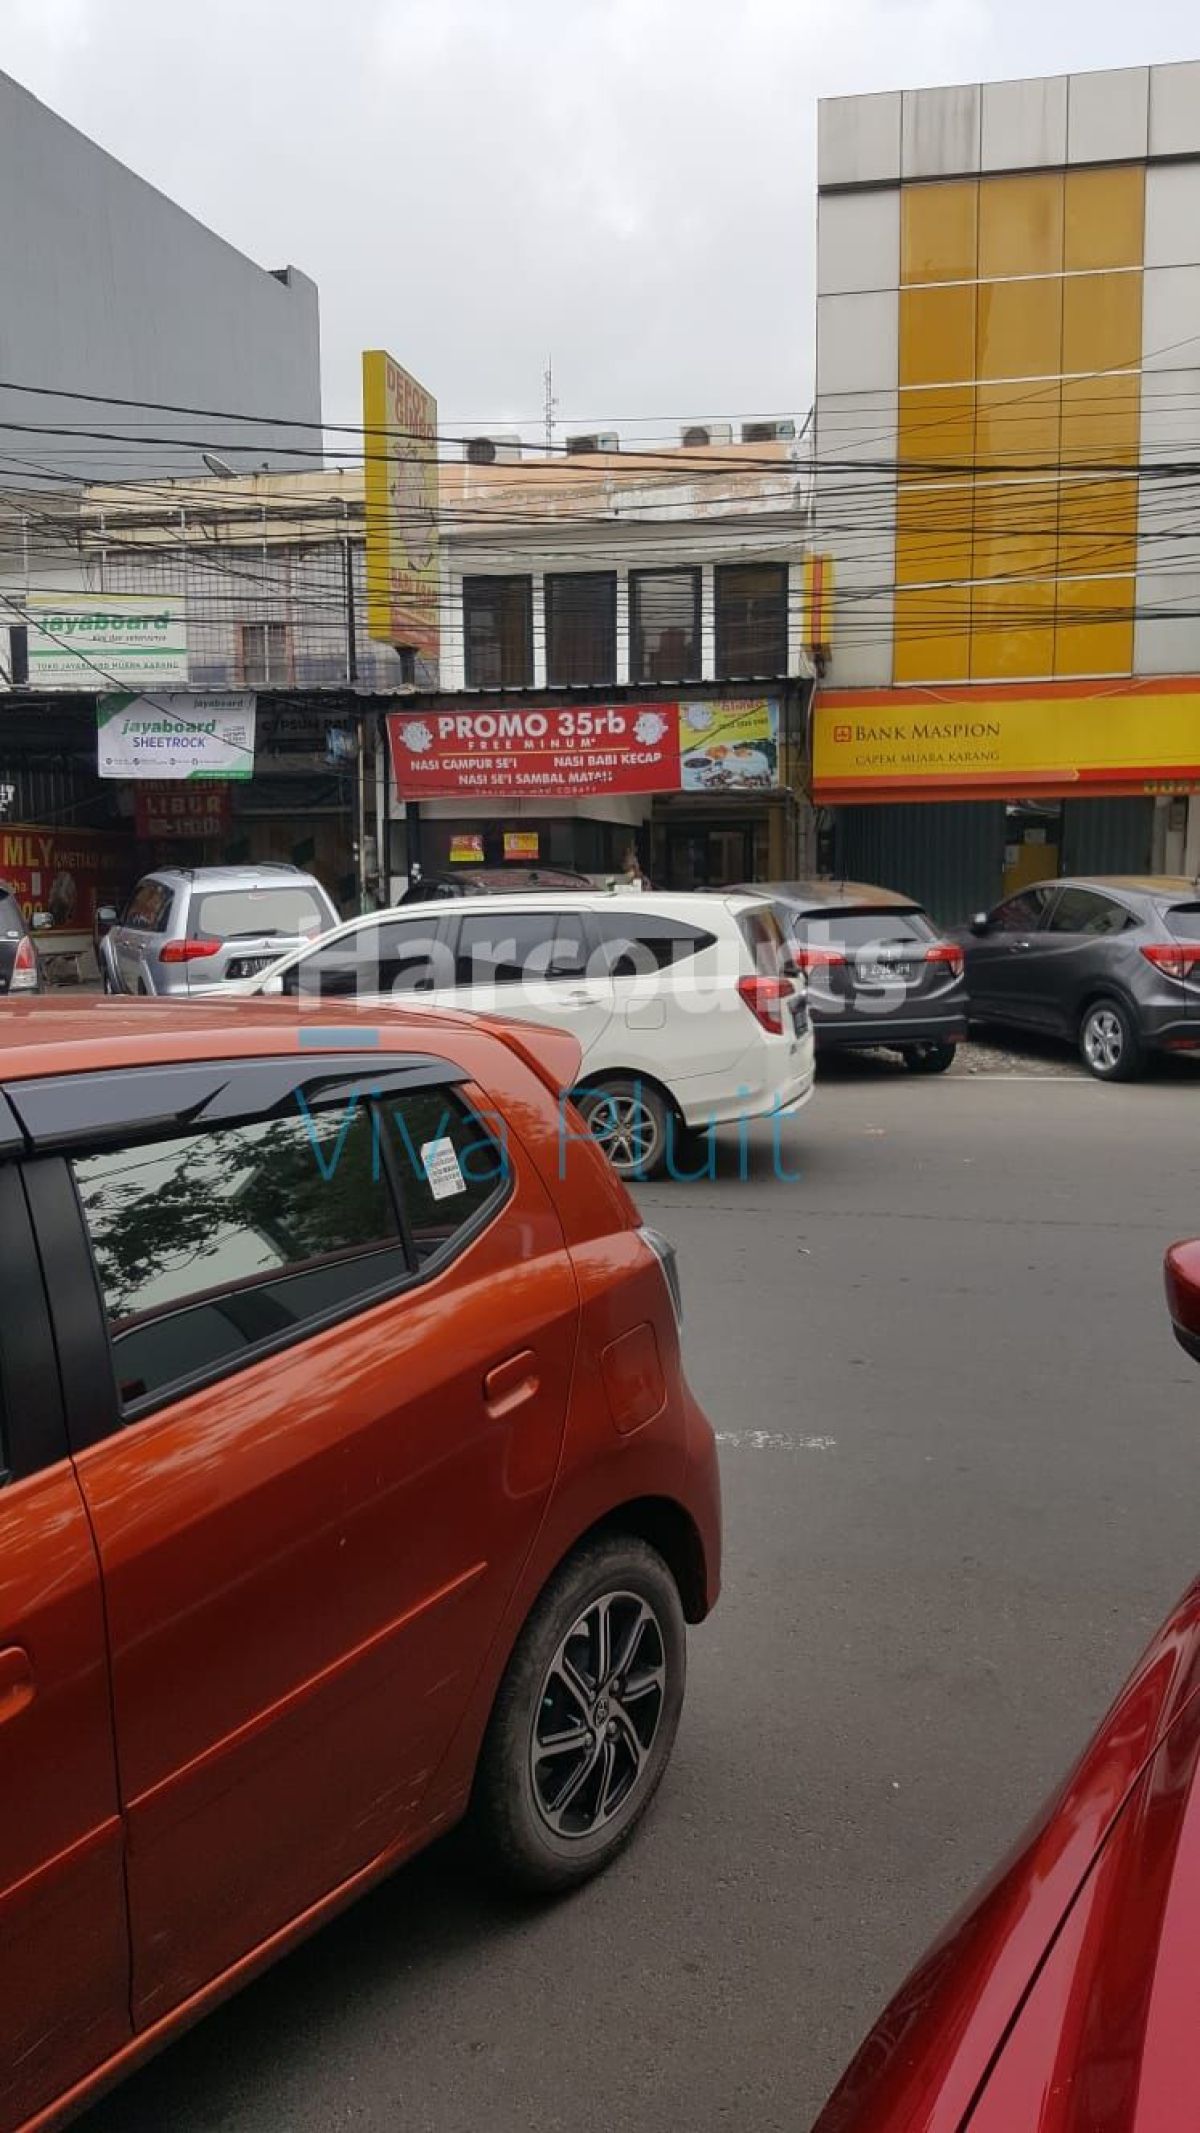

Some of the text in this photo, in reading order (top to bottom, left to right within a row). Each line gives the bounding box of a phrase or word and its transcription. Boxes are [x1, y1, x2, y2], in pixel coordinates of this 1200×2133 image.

[38, 610, 169, 634] jayaboard
[193, 700, 244, 709] jayaboard
[121, 719, 216, 735] jayaboard
[438, 710, 626, 740] PROMO 35rb
[133, 736, 206, 748] SHEETROCK
[468, 741, 512, 751] FREE
[411, 759, 439, 771] NASI
[442, 758, 493, 770] CAMPUR
[554, 752, 663, 767] NASI BABI KECAP
[856, 751, 1000, 766] CAPEM MUARA KARANG
[459, 774, 488, 785] NASI
[515, 772, 566, 785] SAMBAL
